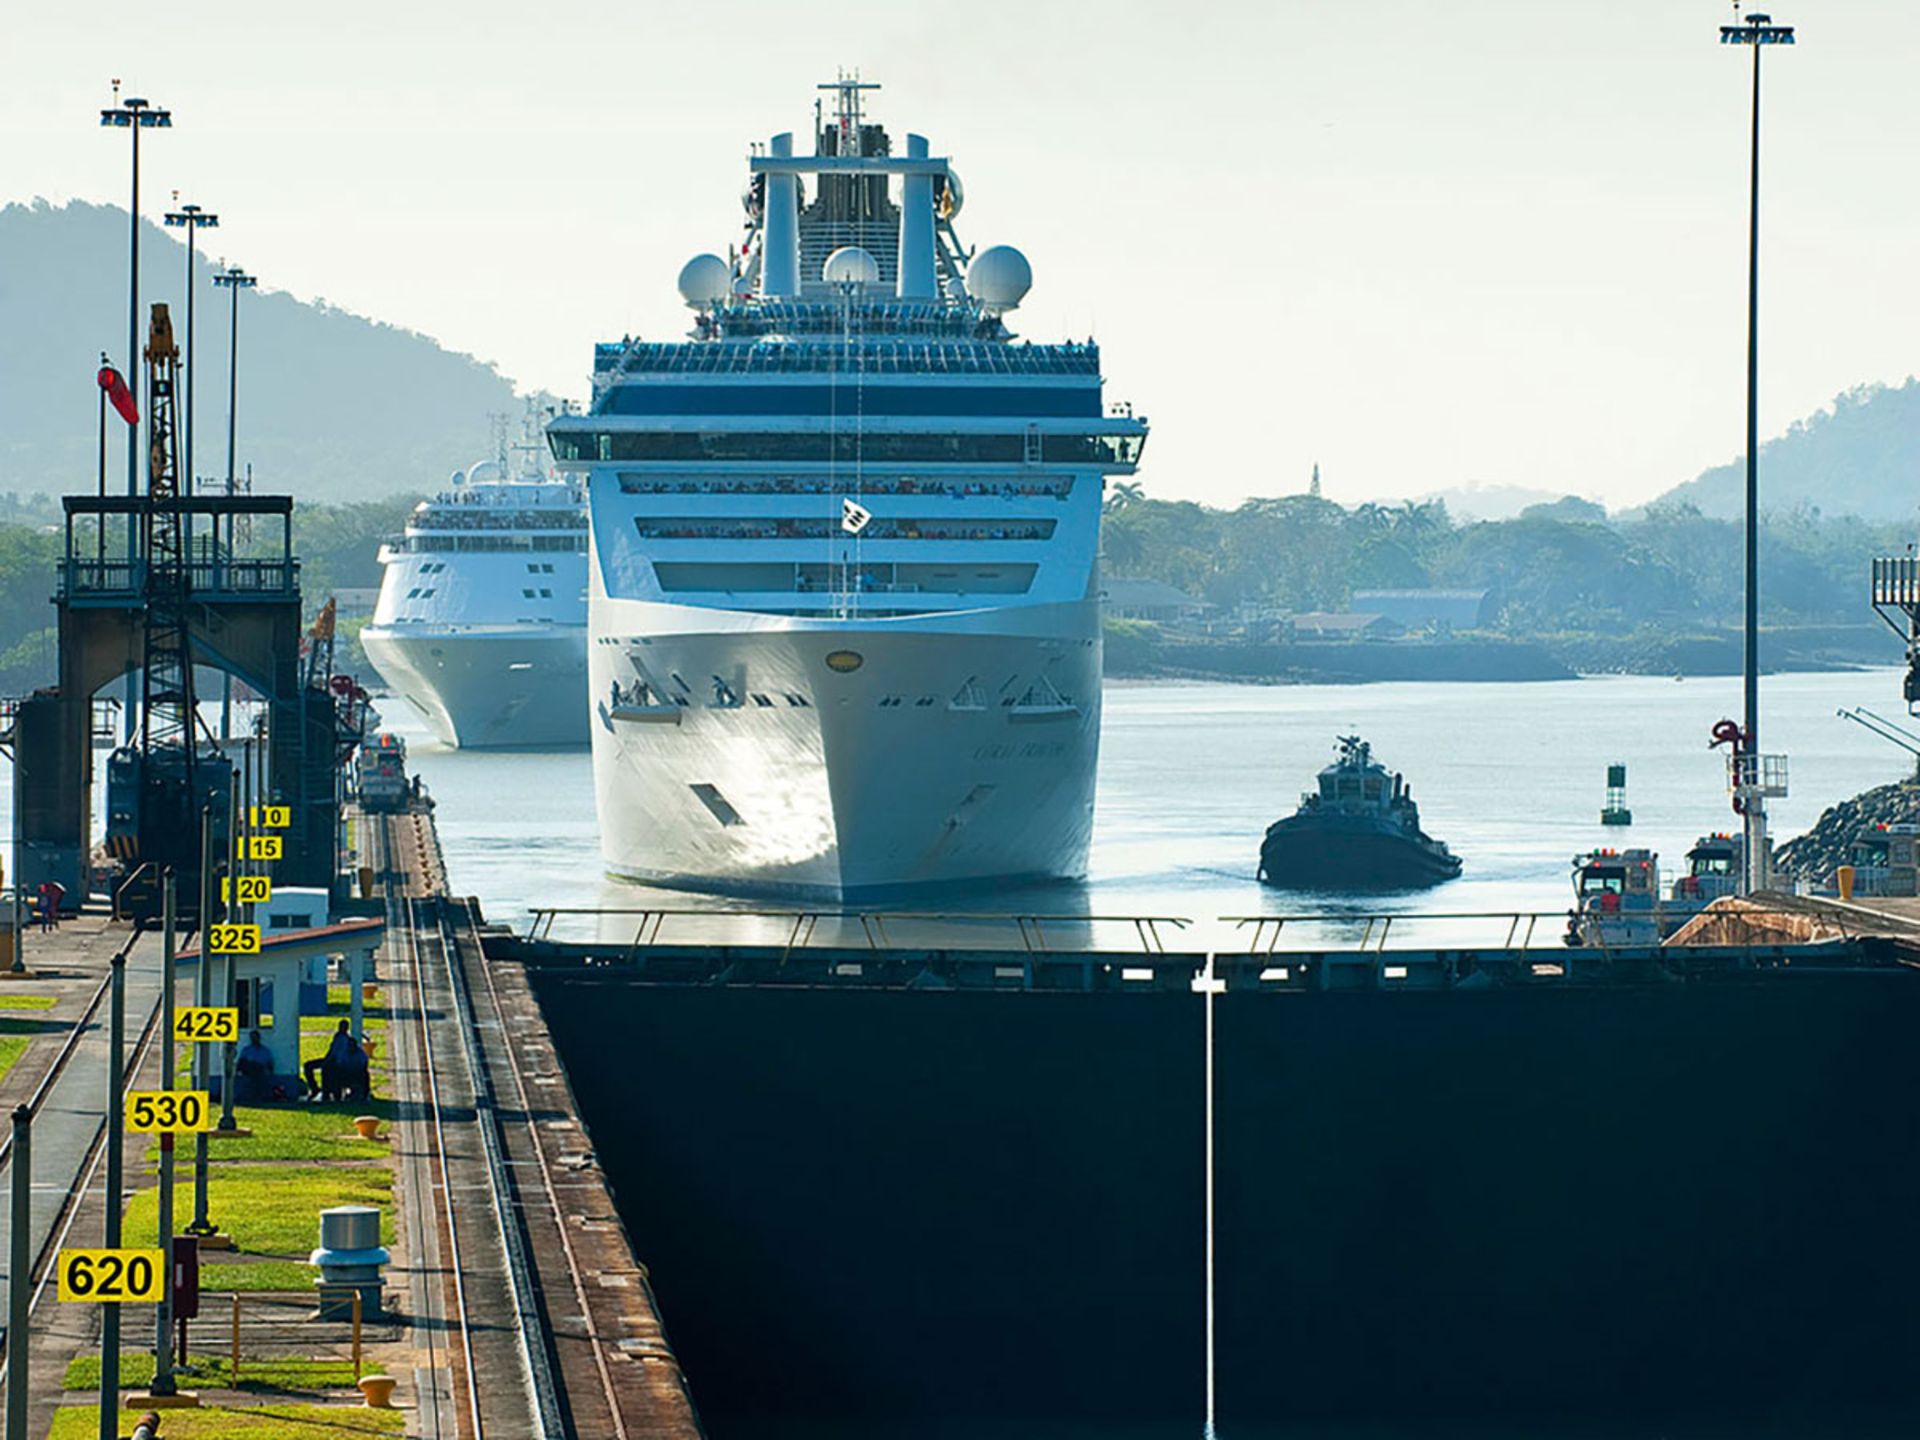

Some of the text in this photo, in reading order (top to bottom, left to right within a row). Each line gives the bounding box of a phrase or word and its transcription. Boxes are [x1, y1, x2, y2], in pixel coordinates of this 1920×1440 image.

[210, 927, 256, 950] 325
[176, 1011, 232, 1037] 425
[133, 1096, 200, 1128] 530
[67, 1256, 153, 1296] 620
